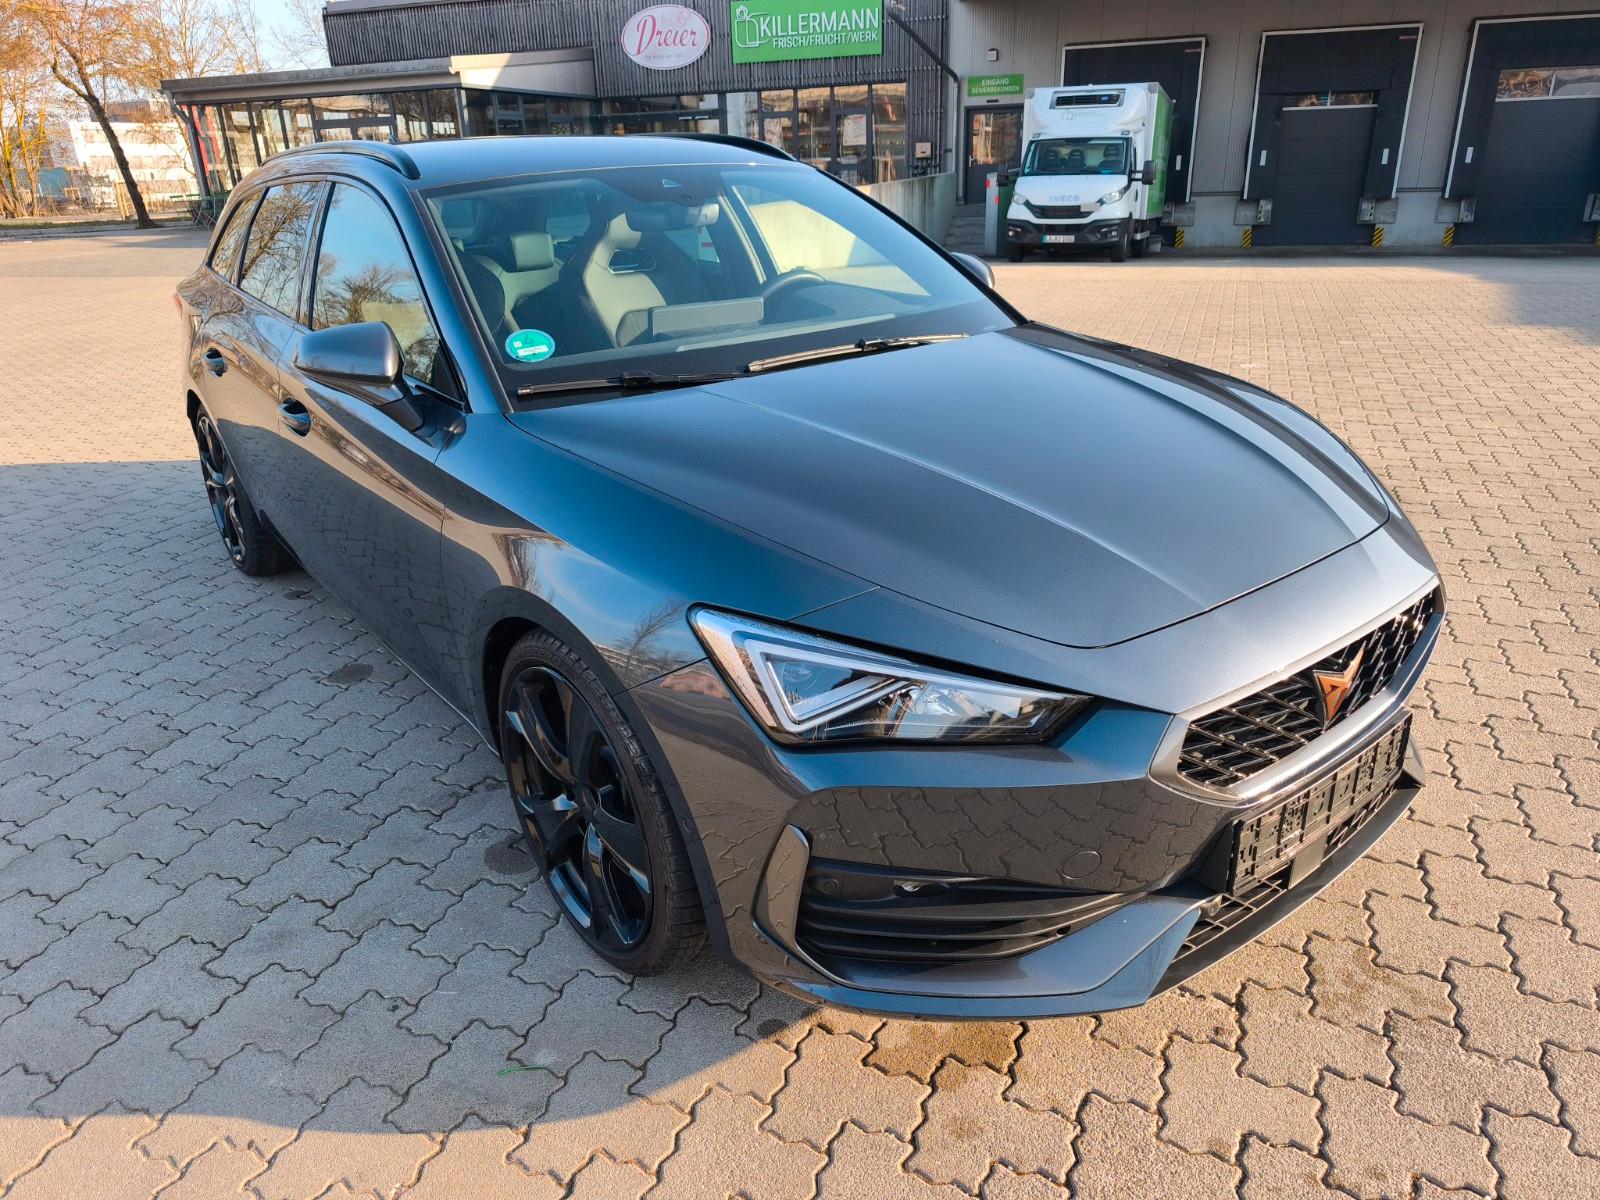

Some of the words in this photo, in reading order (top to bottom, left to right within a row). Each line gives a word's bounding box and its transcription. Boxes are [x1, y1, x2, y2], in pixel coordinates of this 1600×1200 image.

[759, 7, 880, 37] KILLERMANN
[636, 14, 698, 56] Dreier
[981, 77, 1010, 87] EINGANG
[1048, 194, 1081, 203] IVECO
